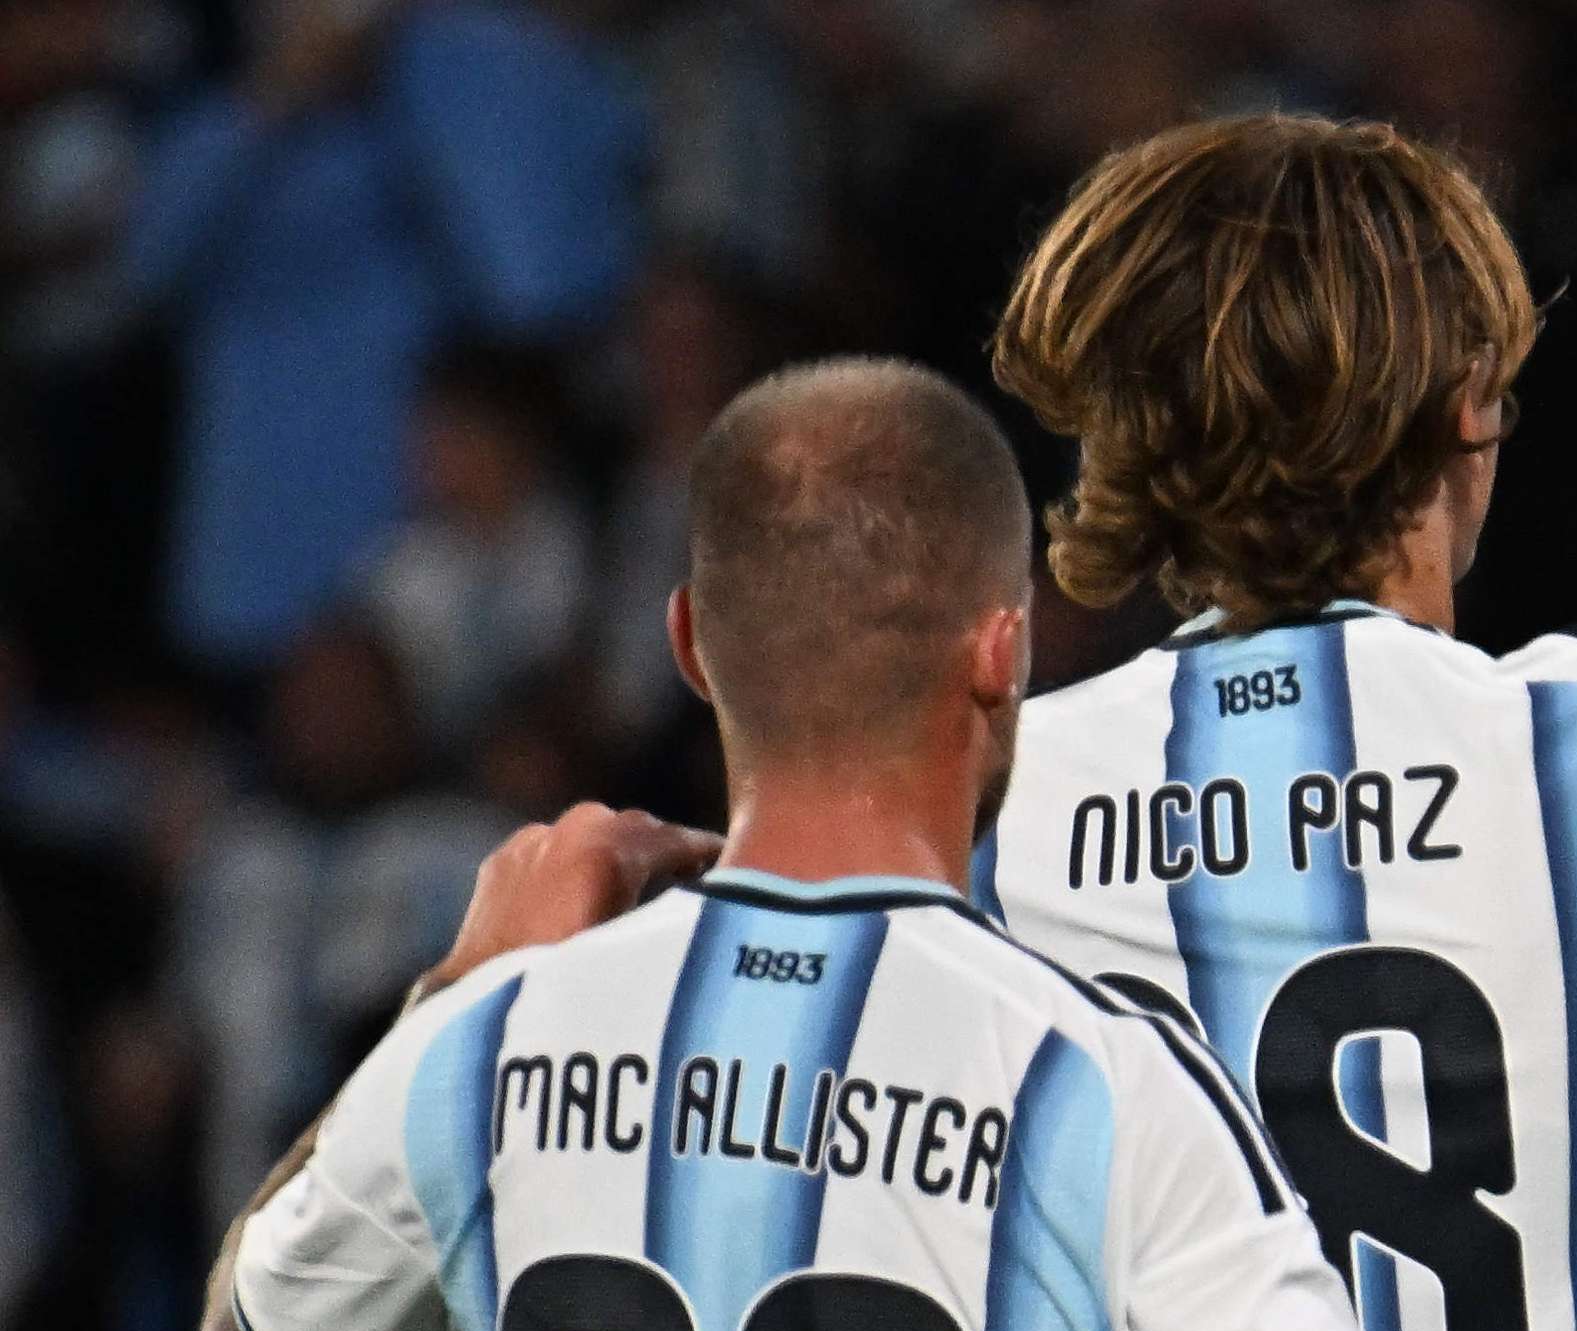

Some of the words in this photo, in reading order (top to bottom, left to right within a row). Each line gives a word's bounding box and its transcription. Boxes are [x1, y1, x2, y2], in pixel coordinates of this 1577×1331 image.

[1214, 664, 1301, 718] 1893
[1067, 775, 1250, 890] NICO
[1288, 763, 1464, 871] PAZ
[734, 944, 827, 985] 1893
[493, 1050, 650, 1156] MAC
[673, 1055, 1008, 1211] ALLISTER
